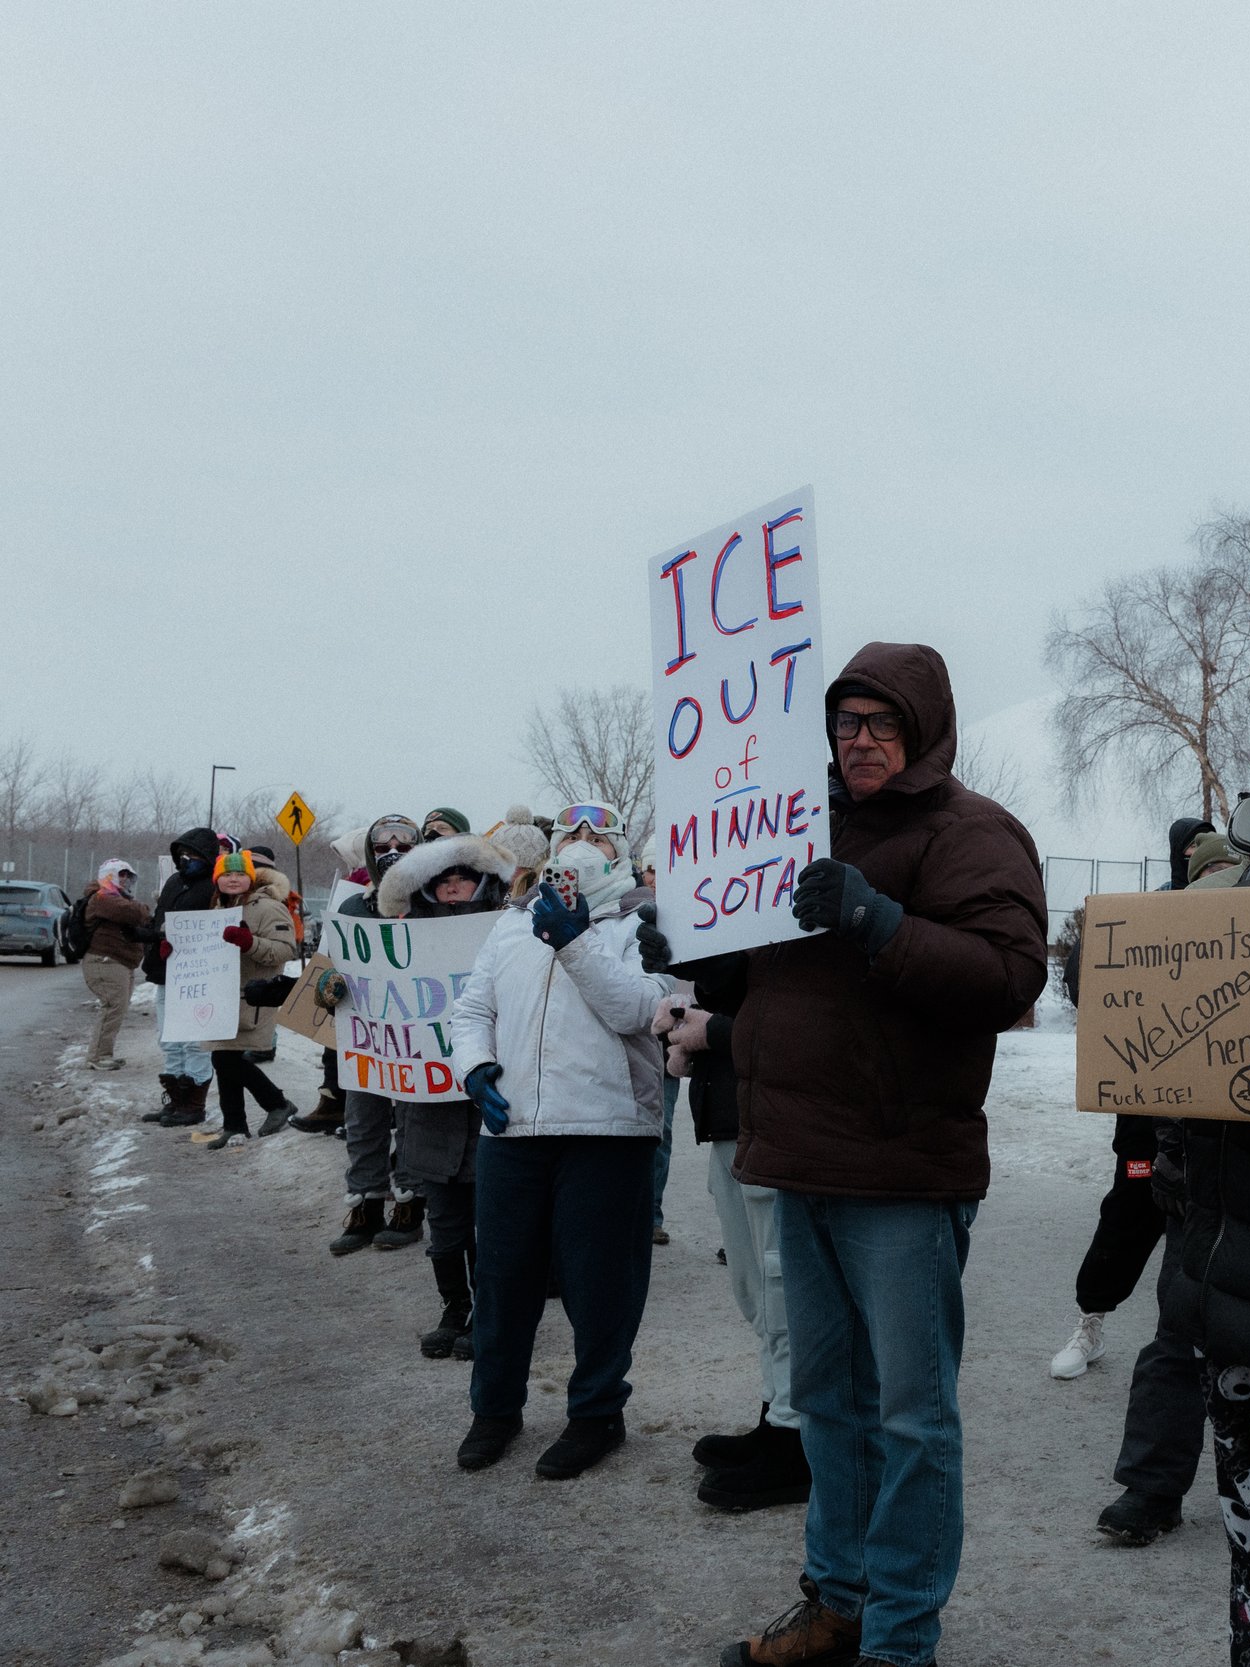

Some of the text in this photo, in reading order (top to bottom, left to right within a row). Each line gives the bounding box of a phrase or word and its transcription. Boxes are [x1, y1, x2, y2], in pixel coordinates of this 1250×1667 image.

[659, 506, 804, 676] ICE
[668, 637, 812, 760] OUT
[714, 734, 760, 790] of
[669, 788, 822, 875] MINNE-
[169, 932, 203, 945] TIRED
[173, 915, 205, 930] GIVE
[331, 919, 412, 970] YOU
[180, 983, 207, 1000] FREE
[1103, 986, 1145, 1009] are
[350, 1015, 422, 1059] DEAL
[344, 1050, 416, 1093] THE
[1152, 1086, 1193, 1105] ICE!
